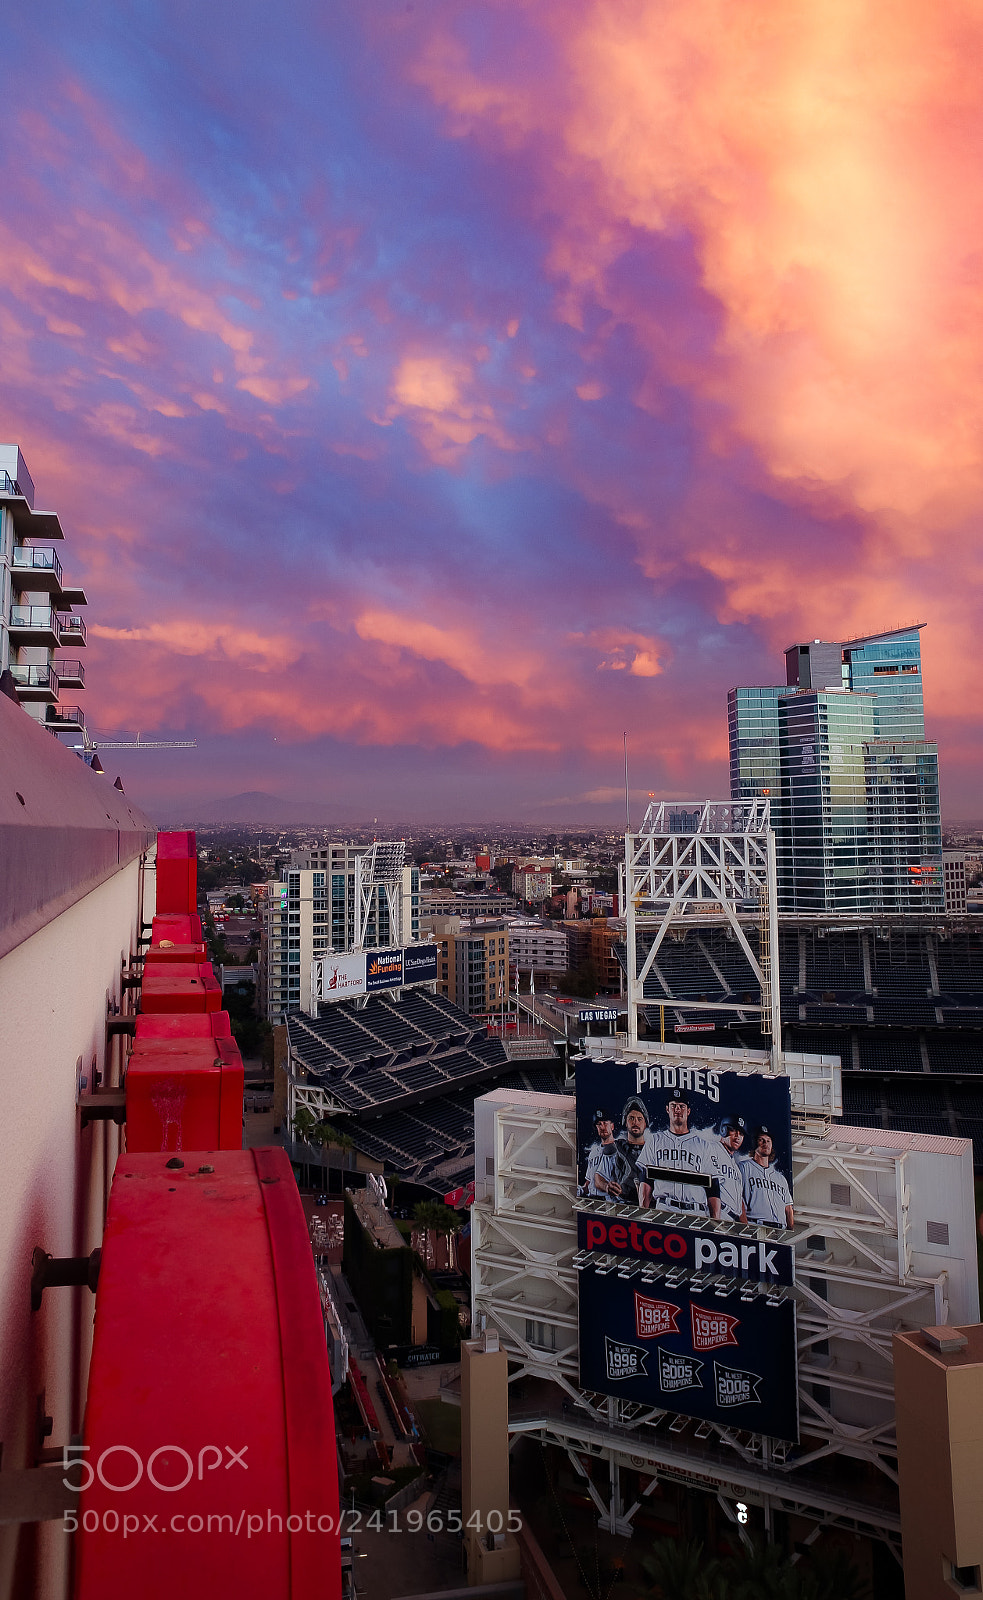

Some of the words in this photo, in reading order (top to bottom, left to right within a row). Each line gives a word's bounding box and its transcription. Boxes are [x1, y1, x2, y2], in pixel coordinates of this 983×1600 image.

[378, 954, 402, 965] National
[378, 963, 402, 974] Funding
[338, 978, 363, 989] HARTFORD
[580, 1012, 594, 1021] LAS
[595, 1010, 617, 1020] VEGAS
[636, 1066, 720, 1102] PADRES
[656, 1149, 702, 1173] PADRES
[748, 1176, 786, 1202] PADRES
[587, 1220, 688, 1258] petco
[694, 1237, 780, 1276] park
[640, 1306, 670, 1324] 1984
[640, 1323, 670, 1334] CHAMPIONS
[696, 1318, 728, 1336] 1998
[696, 1334, 728, 1346] CHAMPIONS
[408, 1352, 440, 1362] CUTWATER
[609, 1351, 637, 1367] 1996
[609, 1366, 638, 1376] CHAMPIONS
[662, 1363, 693, 1379] 2005
[663, 1378, 693, 1388] CHAMPIONS
[718, 1377, 750, 1394] 2006
[719, 1393, 750, 1404] CHAMPIONS
